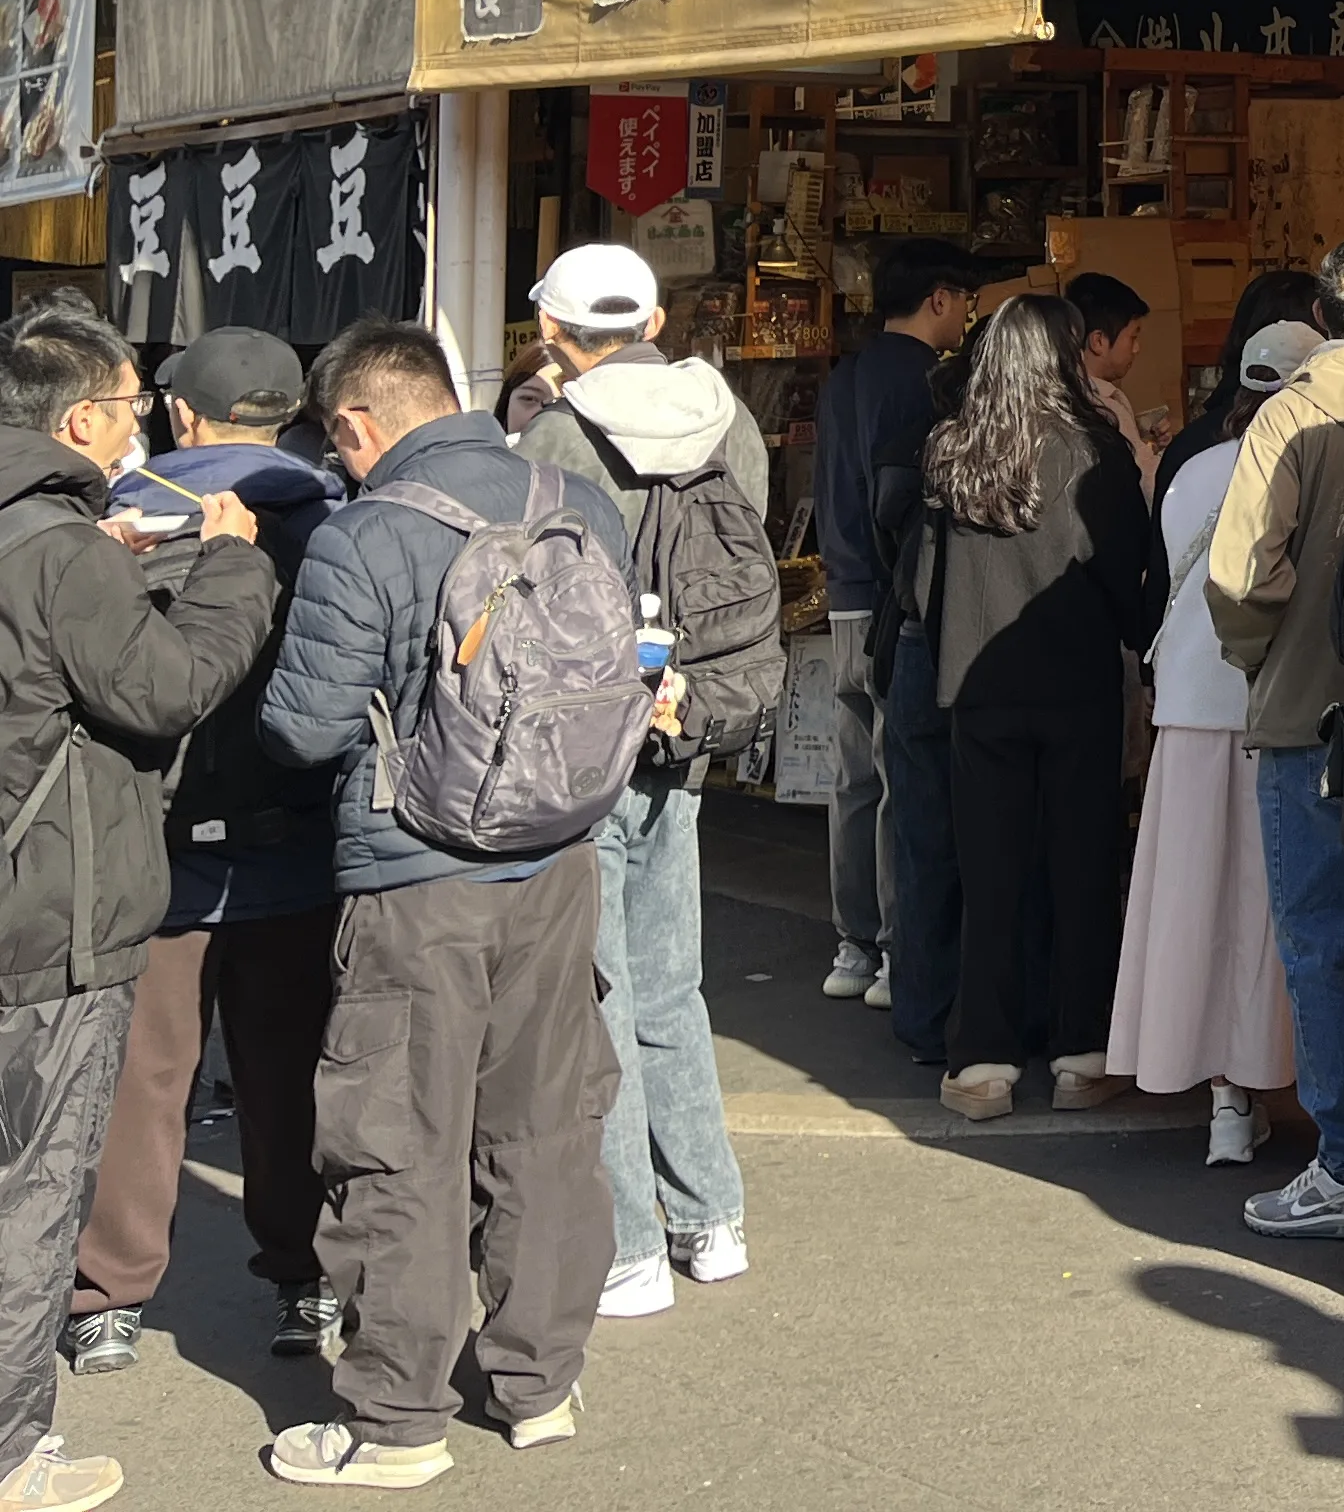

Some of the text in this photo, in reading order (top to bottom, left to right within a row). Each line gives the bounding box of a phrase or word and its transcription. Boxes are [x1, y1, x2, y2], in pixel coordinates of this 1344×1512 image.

[631, 82, 662, 93] PayPay
[617, 117, 639, 202] 使えます。
[641, 104, 662, 178] ペイペイ
[696, 111, 715, 182] 加盟店
[208, 144, 262, 283] 豆
[319, 124, 376, 275] 豆
